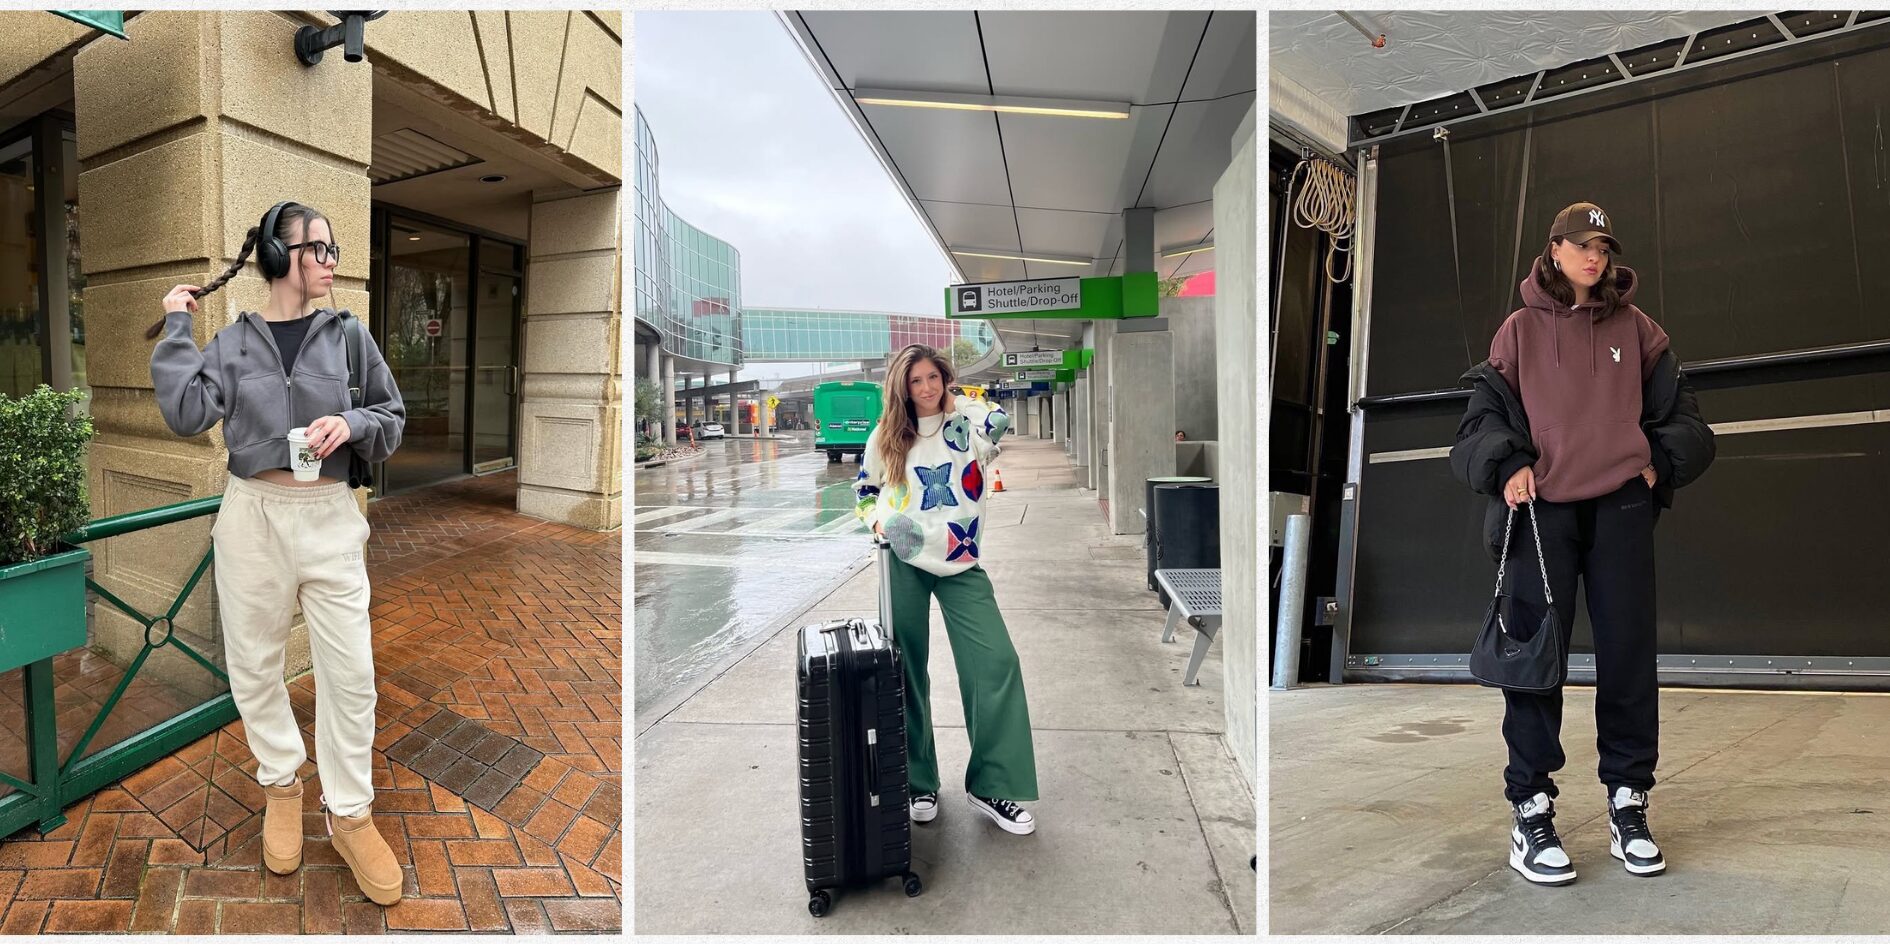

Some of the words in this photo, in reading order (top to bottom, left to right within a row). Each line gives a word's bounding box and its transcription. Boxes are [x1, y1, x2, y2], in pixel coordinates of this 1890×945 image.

[1589, 209, 1605, 228] NY
[987, 283, 1061, 297] Hotel/Parking
[988, 293, 1079, 309] Shuttle/Drop-Off
